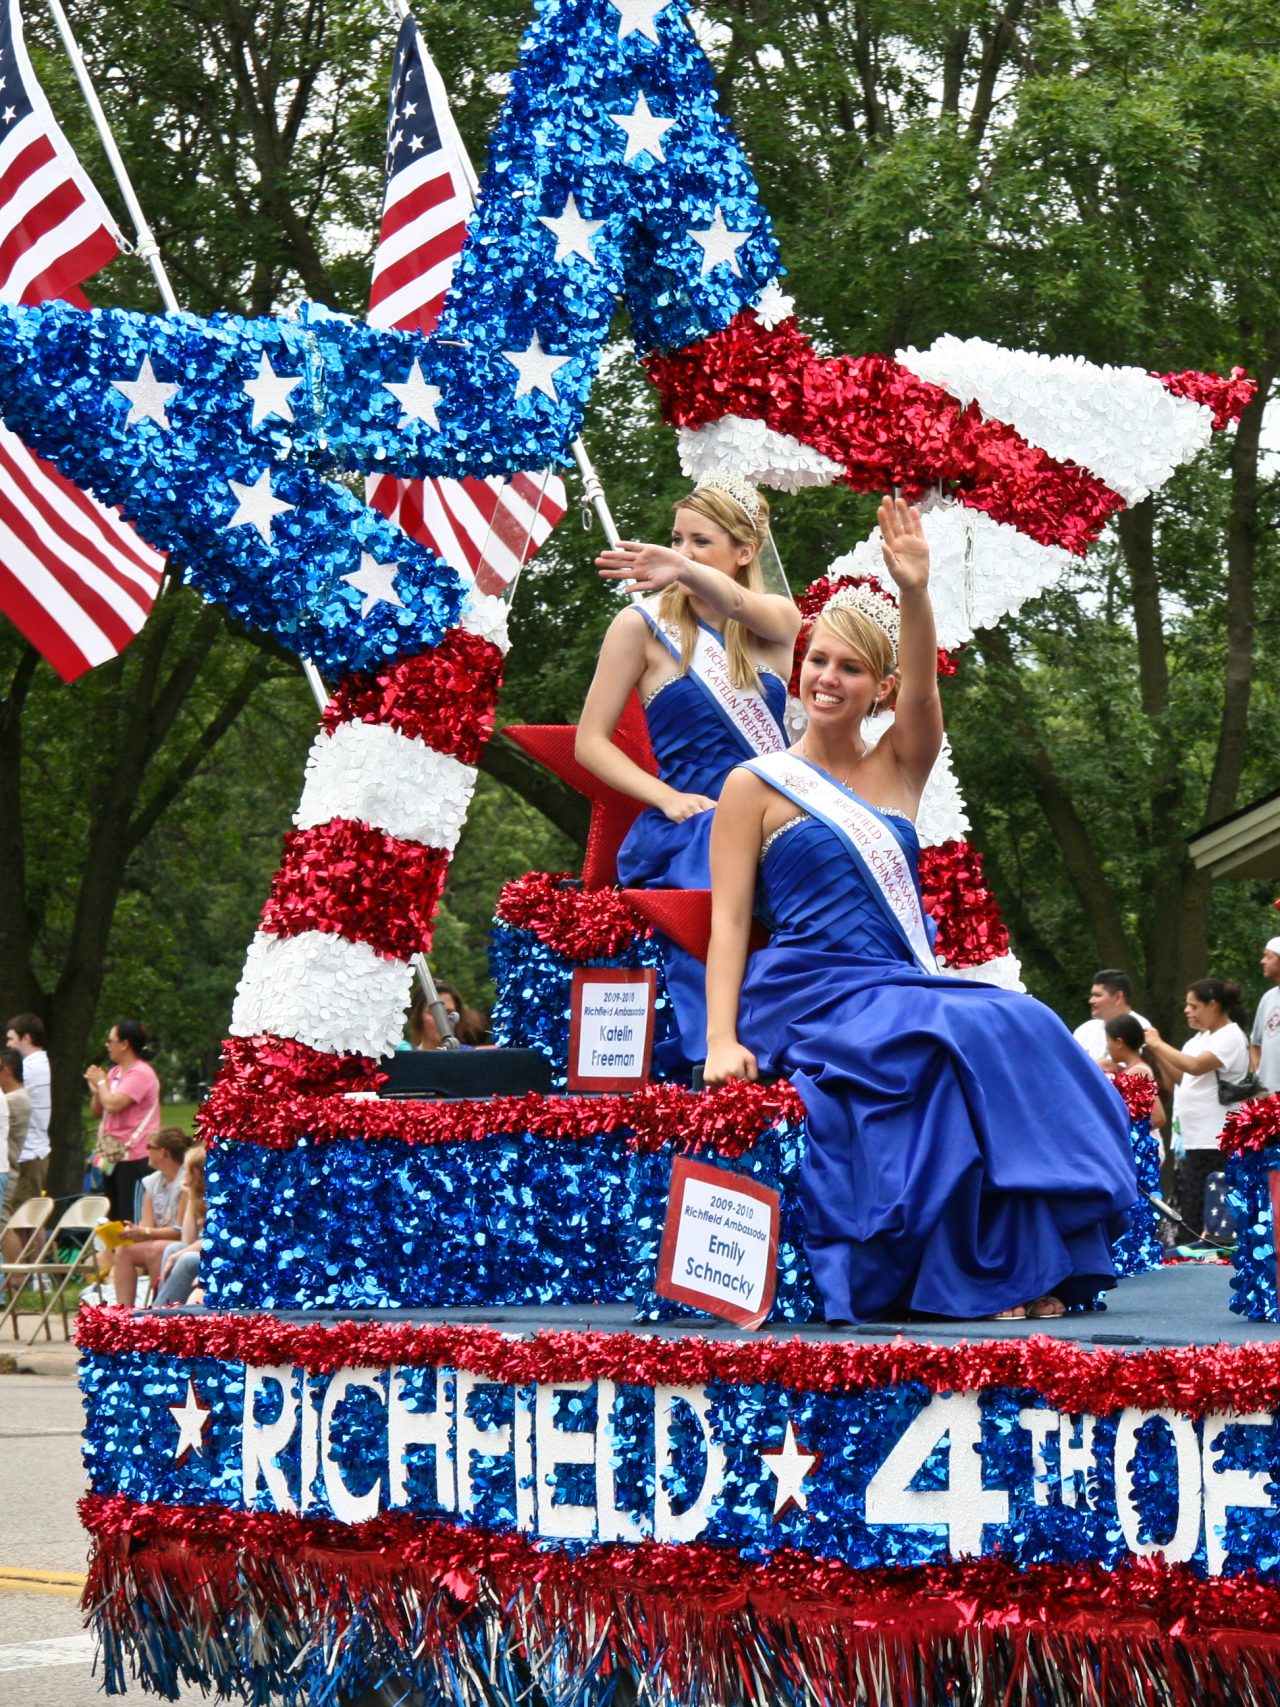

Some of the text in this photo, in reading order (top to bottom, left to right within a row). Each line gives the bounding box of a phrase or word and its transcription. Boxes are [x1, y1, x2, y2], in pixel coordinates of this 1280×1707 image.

[704, 667, 740, 710] KATELIN
[743, 698, 782, 751] AMBASSADO
[833, 798, 919, 925] RICHFIELD AMBASSADOR
[842, 818, 906, 913] EMILY SCHNACKY
[584, 1006, 645, 1017] Richfield Ambassador
[603, 992, 635, 1003] 2009-2010
[600, 1025, 633, 1042] Katelin
[591, 1050, 635, 1067] Freeman
[684, 1205, 767, 1242] Richfield Ambassador
[710, 1196, 754, 1220] 2009-2010
[708, 1234, 746, 1267] Emily
[685, 1256, 755, 1301] Schnacky
[242, 1363, 725, 1543] RICHFIELD
